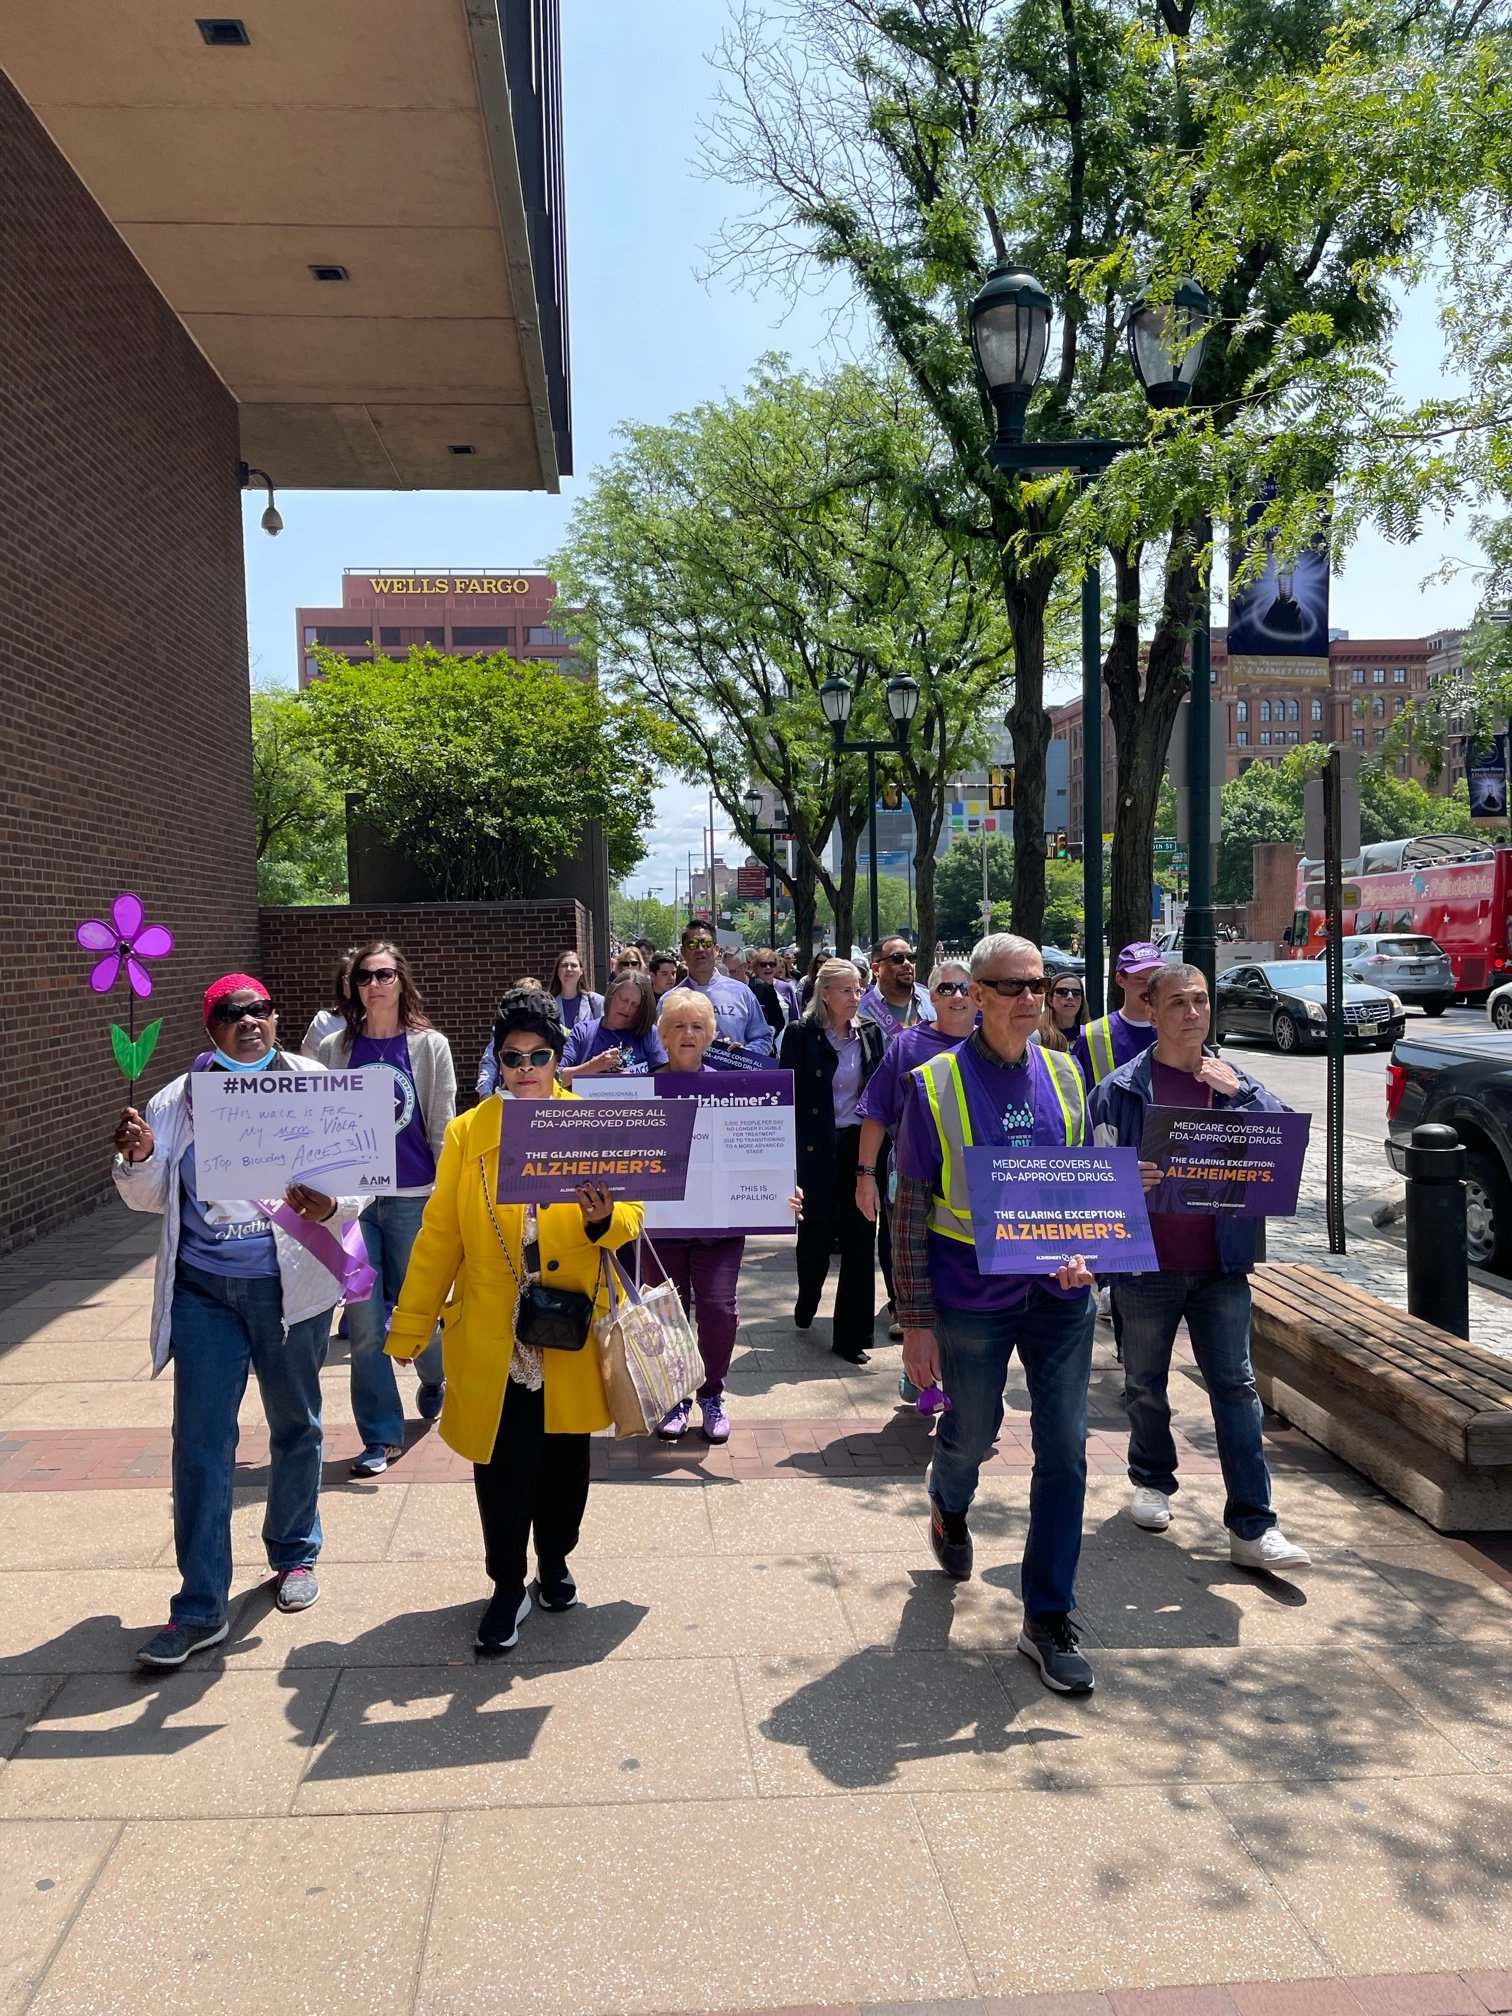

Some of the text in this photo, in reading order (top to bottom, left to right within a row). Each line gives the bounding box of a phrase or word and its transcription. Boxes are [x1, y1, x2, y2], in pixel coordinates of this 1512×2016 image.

[369, 578, 529, 594] WELLS FARGO
[1430, 875, 1493, 898] Philadelphia
[713, 1005, 736, 1016] ALZ
[703, 1051, 742, 1068] DA-APPROVED
[708, 1046, 730, 1058] EDICARE
[732, 1054, 753, 1064] COVERS
[223, 1074, 364, 1094] #MORETIME
[534, 1108, 666, 1118] MEDICARE COVERS ALL
[530, 1118, 668, 1128] FDA-APPROVED DRUGS.
[1174, 1122, 1282, 1134] MEDICARE COVERS ALL
[1169, 1132, 1283, 1145] FDA-APPROVED DRUGS.
[525, 1149, 667, 1160] THE GLARING EXCEPTION:
[993, 1159, 1112, 1169] MEDICARE COVERS ALL
[1189, 1158, 1225, 1166] GLARING
[1227, 1160, 1275, 1168] EXCEPTION:
[370, 1176, 390, 1186] AIM
[992, 1172, 1117, 1182] FDA-APPROVED DRUGS.
[994, 1210, 1126, 1220] THE GLARING EXCEPTION:
